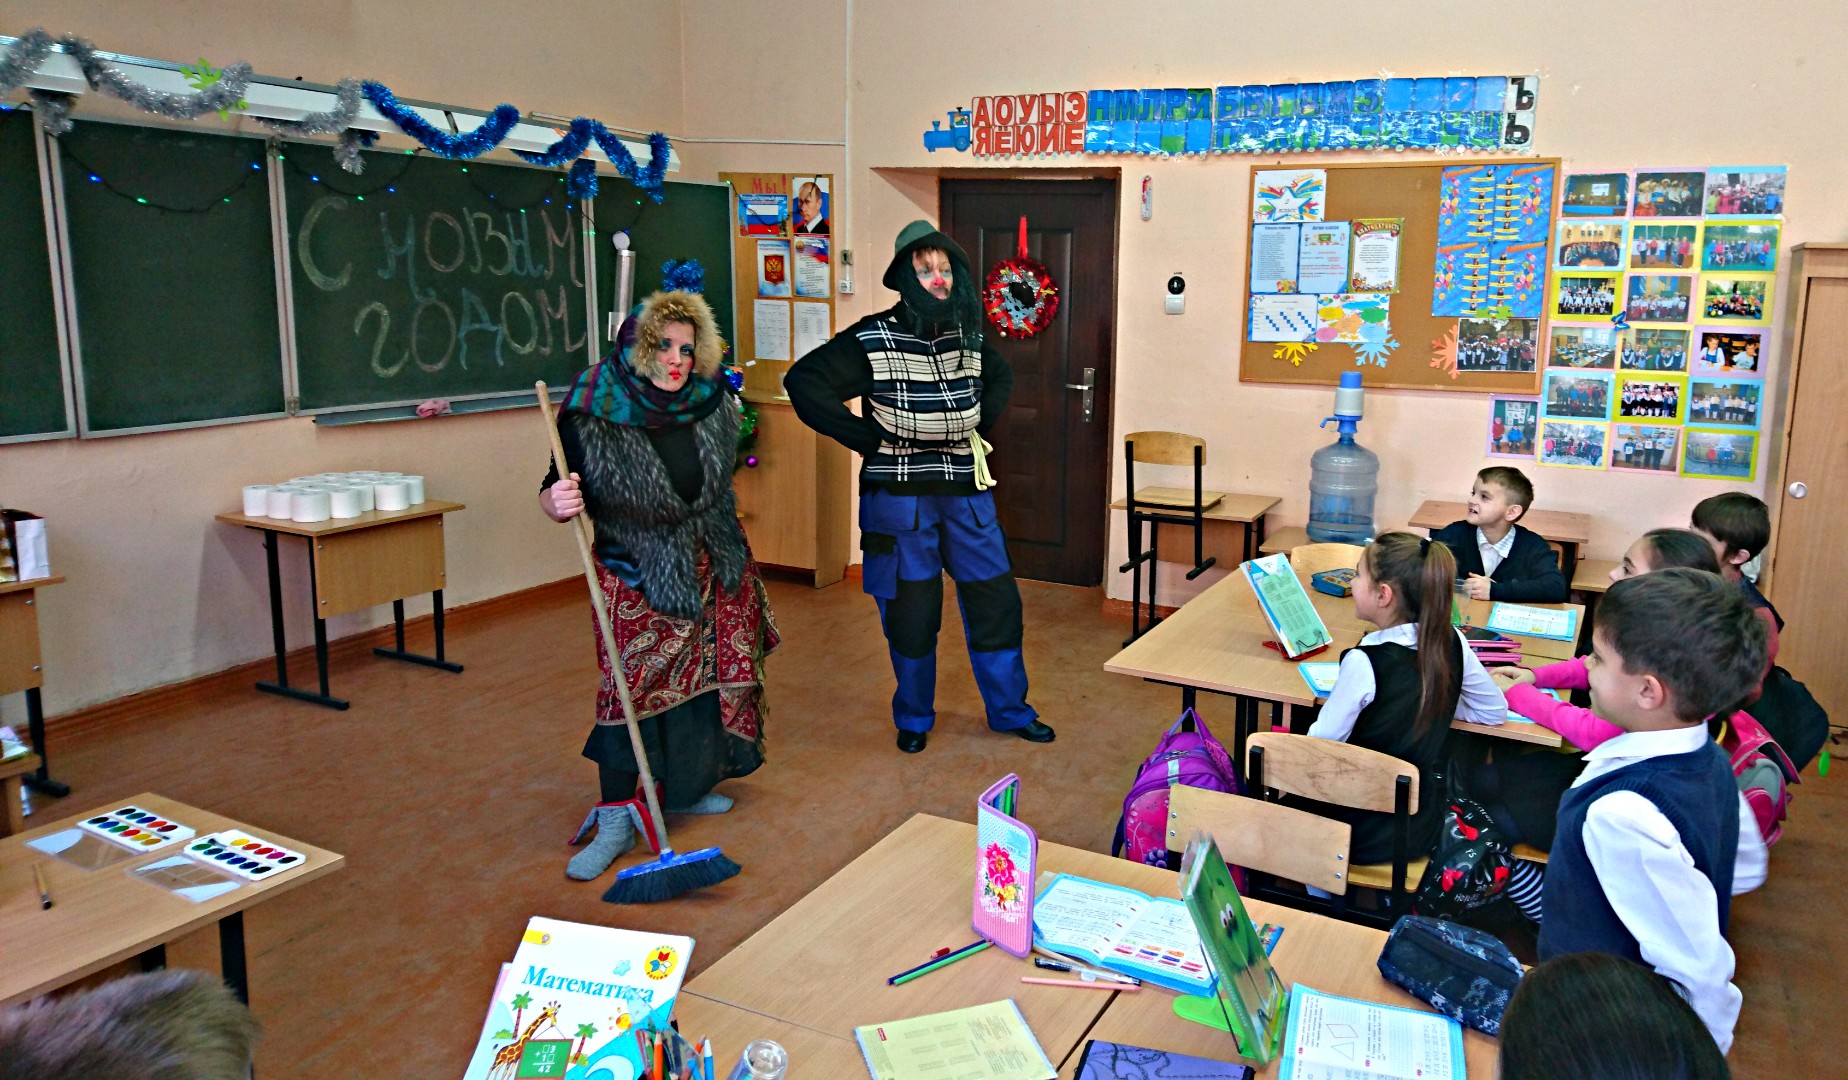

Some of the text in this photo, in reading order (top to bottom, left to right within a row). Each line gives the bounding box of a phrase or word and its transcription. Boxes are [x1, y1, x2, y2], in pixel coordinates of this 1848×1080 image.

[298, 196, 351, 291] С
[521, 964, 655, 1003] Математика
[537, 1064, 551, 1074] 42
